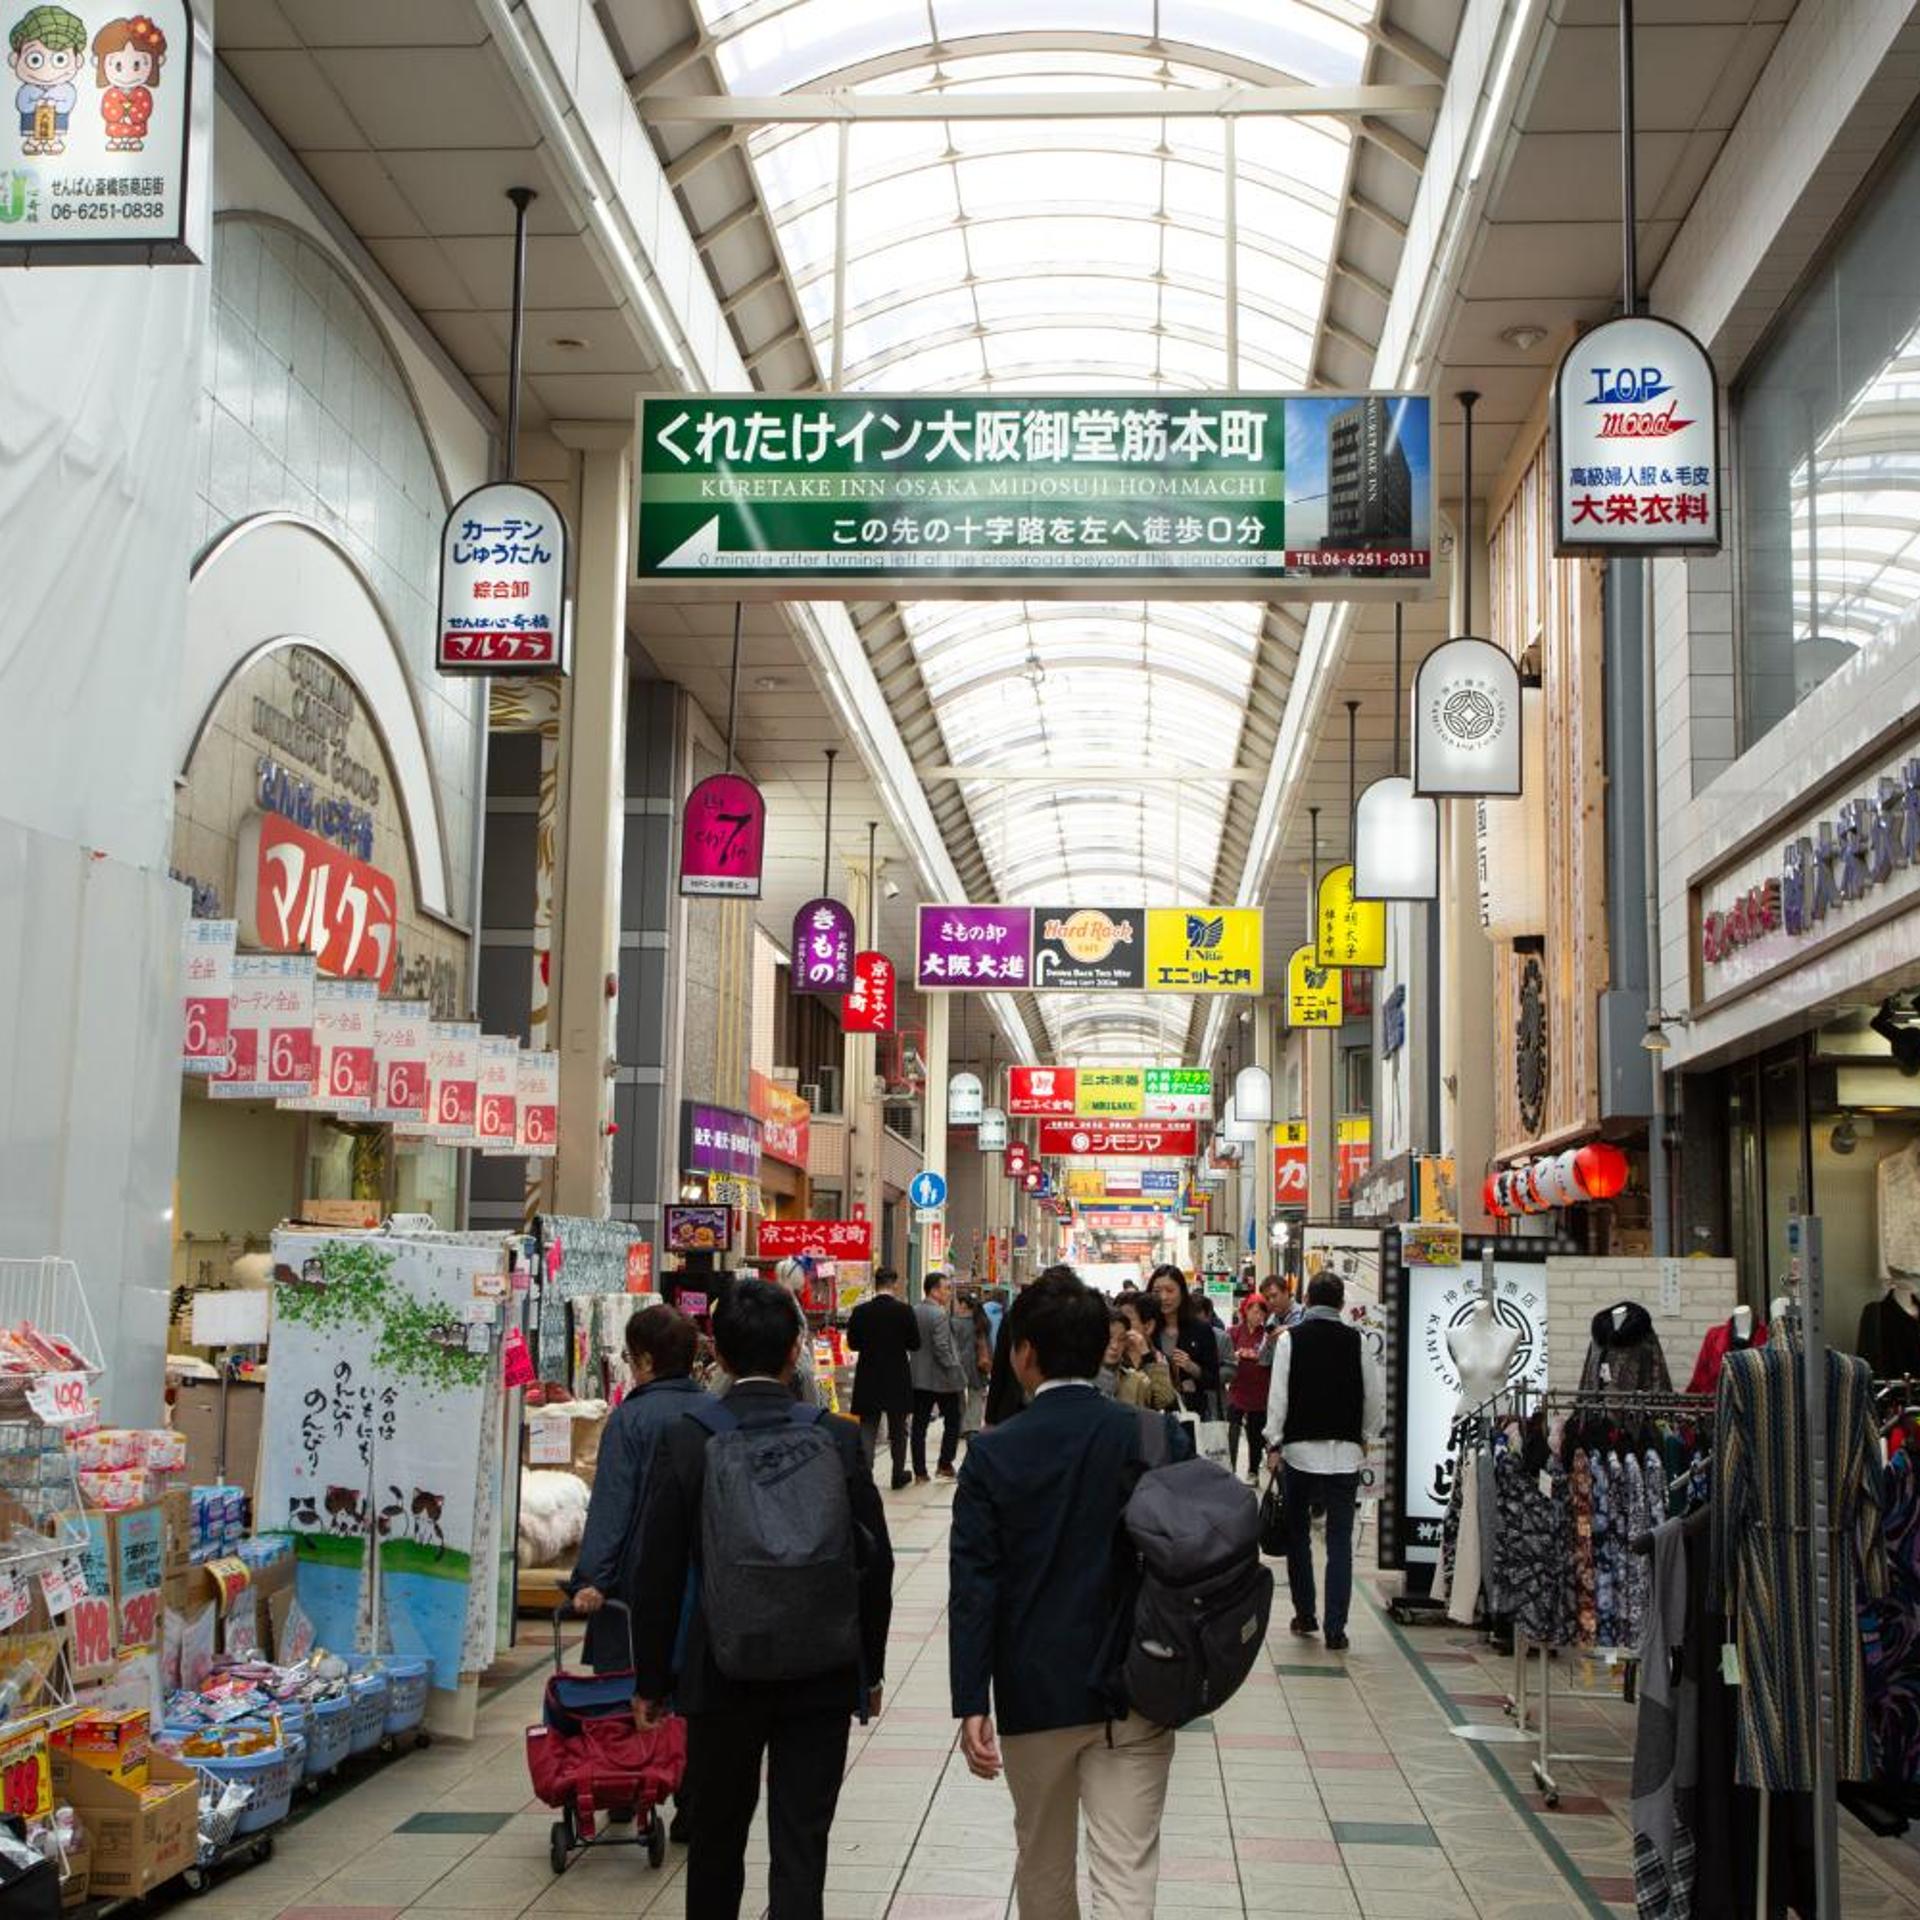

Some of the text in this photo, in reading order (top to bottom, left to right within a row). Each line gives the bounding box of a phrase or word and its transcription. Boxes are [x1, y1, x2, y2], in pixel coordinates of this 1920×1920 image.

[52, 203, 164, 220] 06-6251-0838
[1591, 368, 1662, 401] TOP
[1601, 400, 1678, 436] mood
[656, 410, 1267, 464] くれたけイン大阪御堂筋本町
[700, 478, 1267, 497] KURETAKE INN OSAKA MIDOSUJI HOMMACHI
[1572, 493, 1708, 524] 大栄衣料
[462, 519, 543, 540] カーテン
[453, 544, 552, 564] じゅうたん
[714, 552, 772, 566] minute
[779, 552, 818, 566] after
[825, 552, 884, 569] turning
[890, 552, 916, 566] left
[949, 552, 975, 566] the
[981, 552, 1065, 566] crossroad
[1072, 552, 1138, 569] beyond
[1182, 552, 1266, 569] signboard
[1296, 553, 1424, 565] TEL.06-6251-0311
[447, 635, 546, 657] マルクラ
[266, 843, 392, 977] マルクラ
[809, 907, 836, 984] きもの
[940, 921, 1007, 944] きもの卸
[1043, 919, 1134, 943] Hard Rock
[922, 953, 1025, 980] 大阪大進
[870, 960, 889, 1030] 京ごふく
[272, 1033, 293, 1077] 6
[334, 1051, 354, 1093] 6
[390, 1066, 409, 1105] 6
[442, 1084, 459, 1122] 6
[483, 1099, 499, 1135] 6
[526, 1108, 543, 1141] 6
[1092, 1133, 1162, 1151] シモジマ
[762, 1224, 866, 1245] 京ごふく室町
[380, 1386, 398, 1440] 今日は
